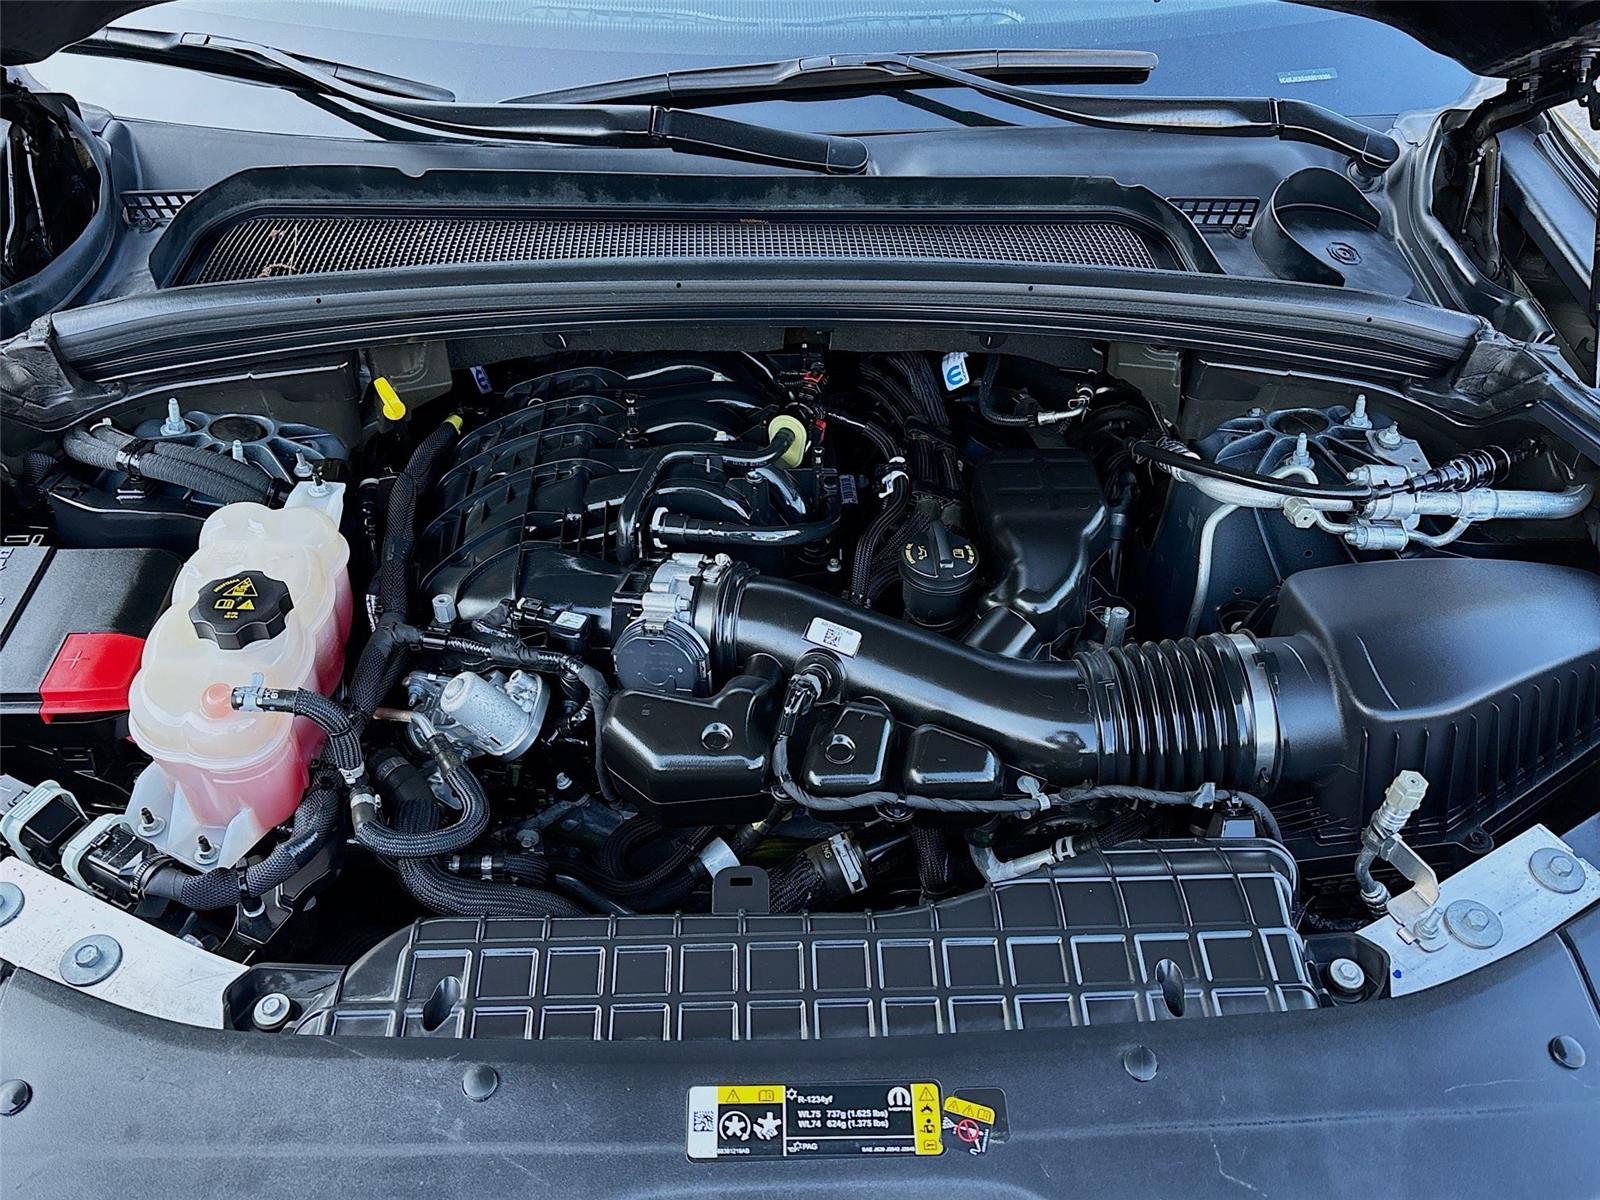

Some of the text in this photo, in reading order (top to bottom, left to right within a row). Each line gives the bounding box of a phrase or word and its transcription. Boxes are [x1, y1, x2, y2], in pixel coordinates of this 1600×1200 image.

[797, 1095, 834, 1105] R-1234yf
[797, 1109, 889, 1119] WL75 737g (1.625 lbs)
[797, 1119, 890, 1129] WL74 624g (1.375 lbs)
